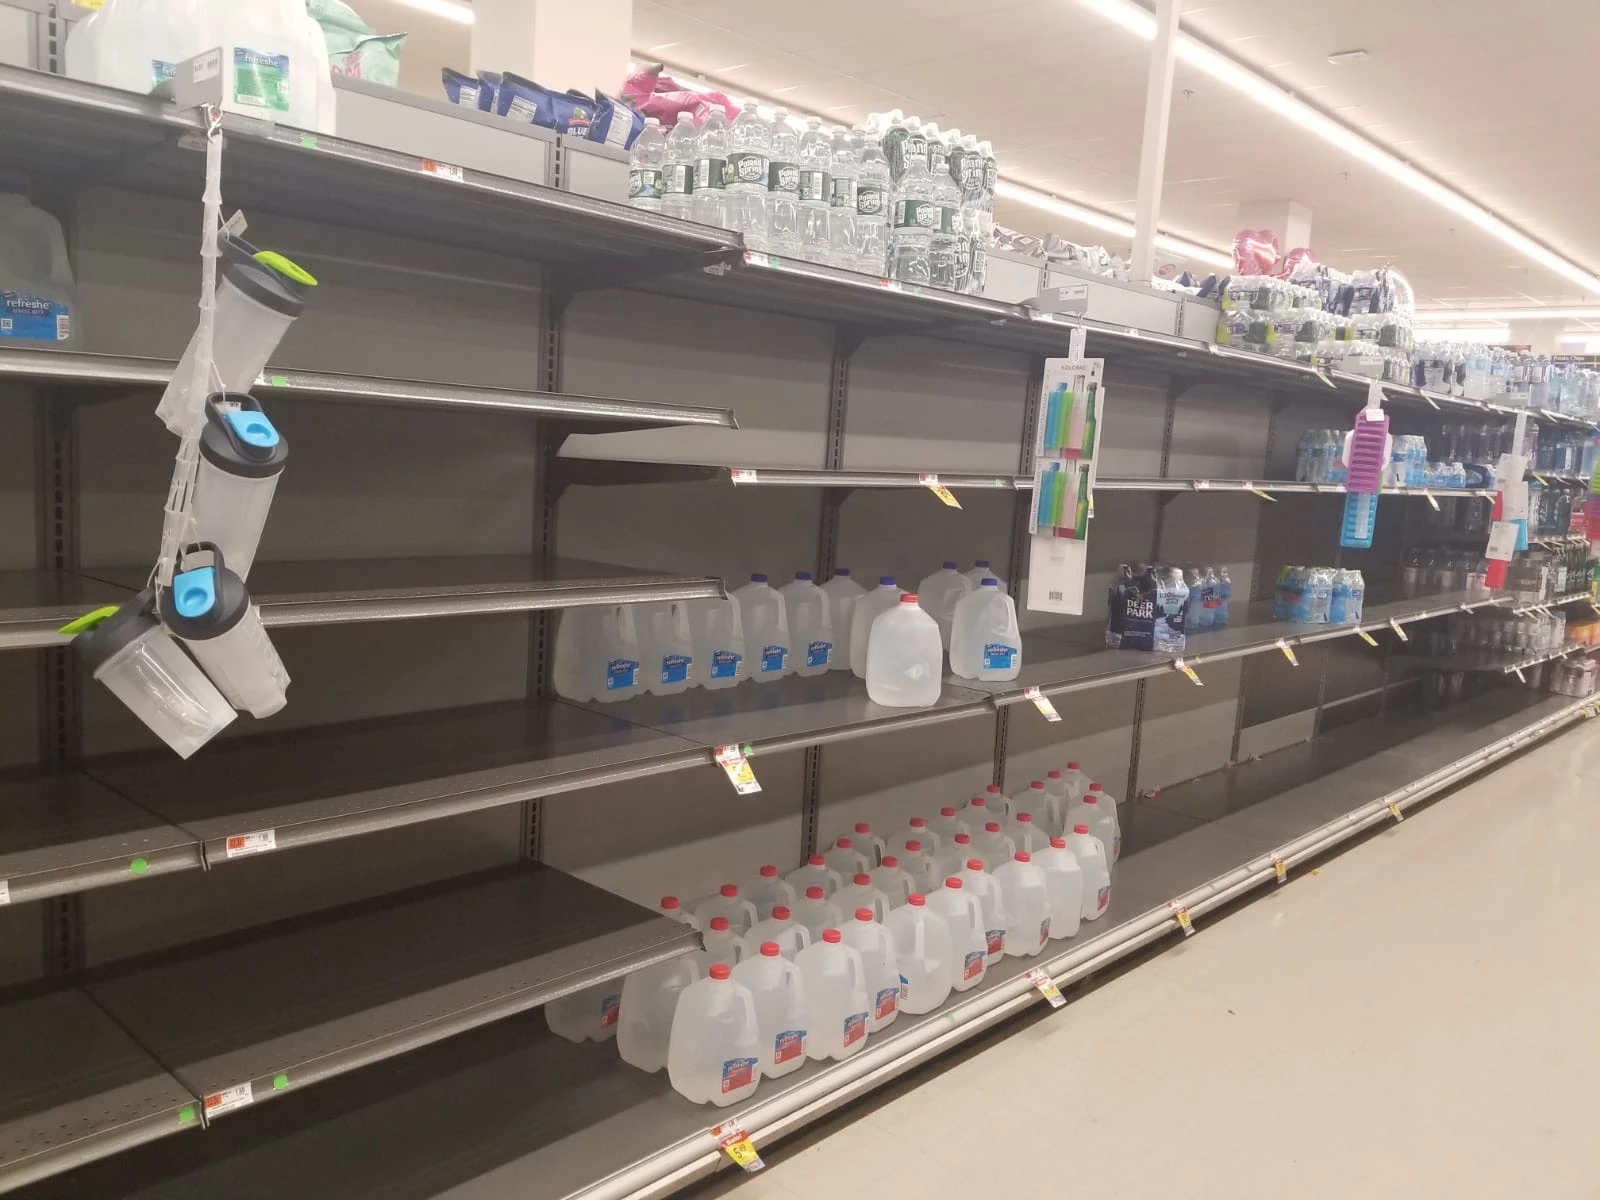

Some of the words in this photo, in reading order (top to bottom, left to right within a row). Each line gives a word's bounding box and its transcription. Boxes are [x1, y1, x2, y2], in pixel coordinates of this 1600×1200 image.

[245, 54, 281, 67] refreshe
[567, 126, 589, 138] BLUE
[738, 158, 762, 169] Poland
[7, 298, 50, 311] refreshe
[1127, 599, 1154, 611] DEER
[1126, 607, 1154, 619] PARK
